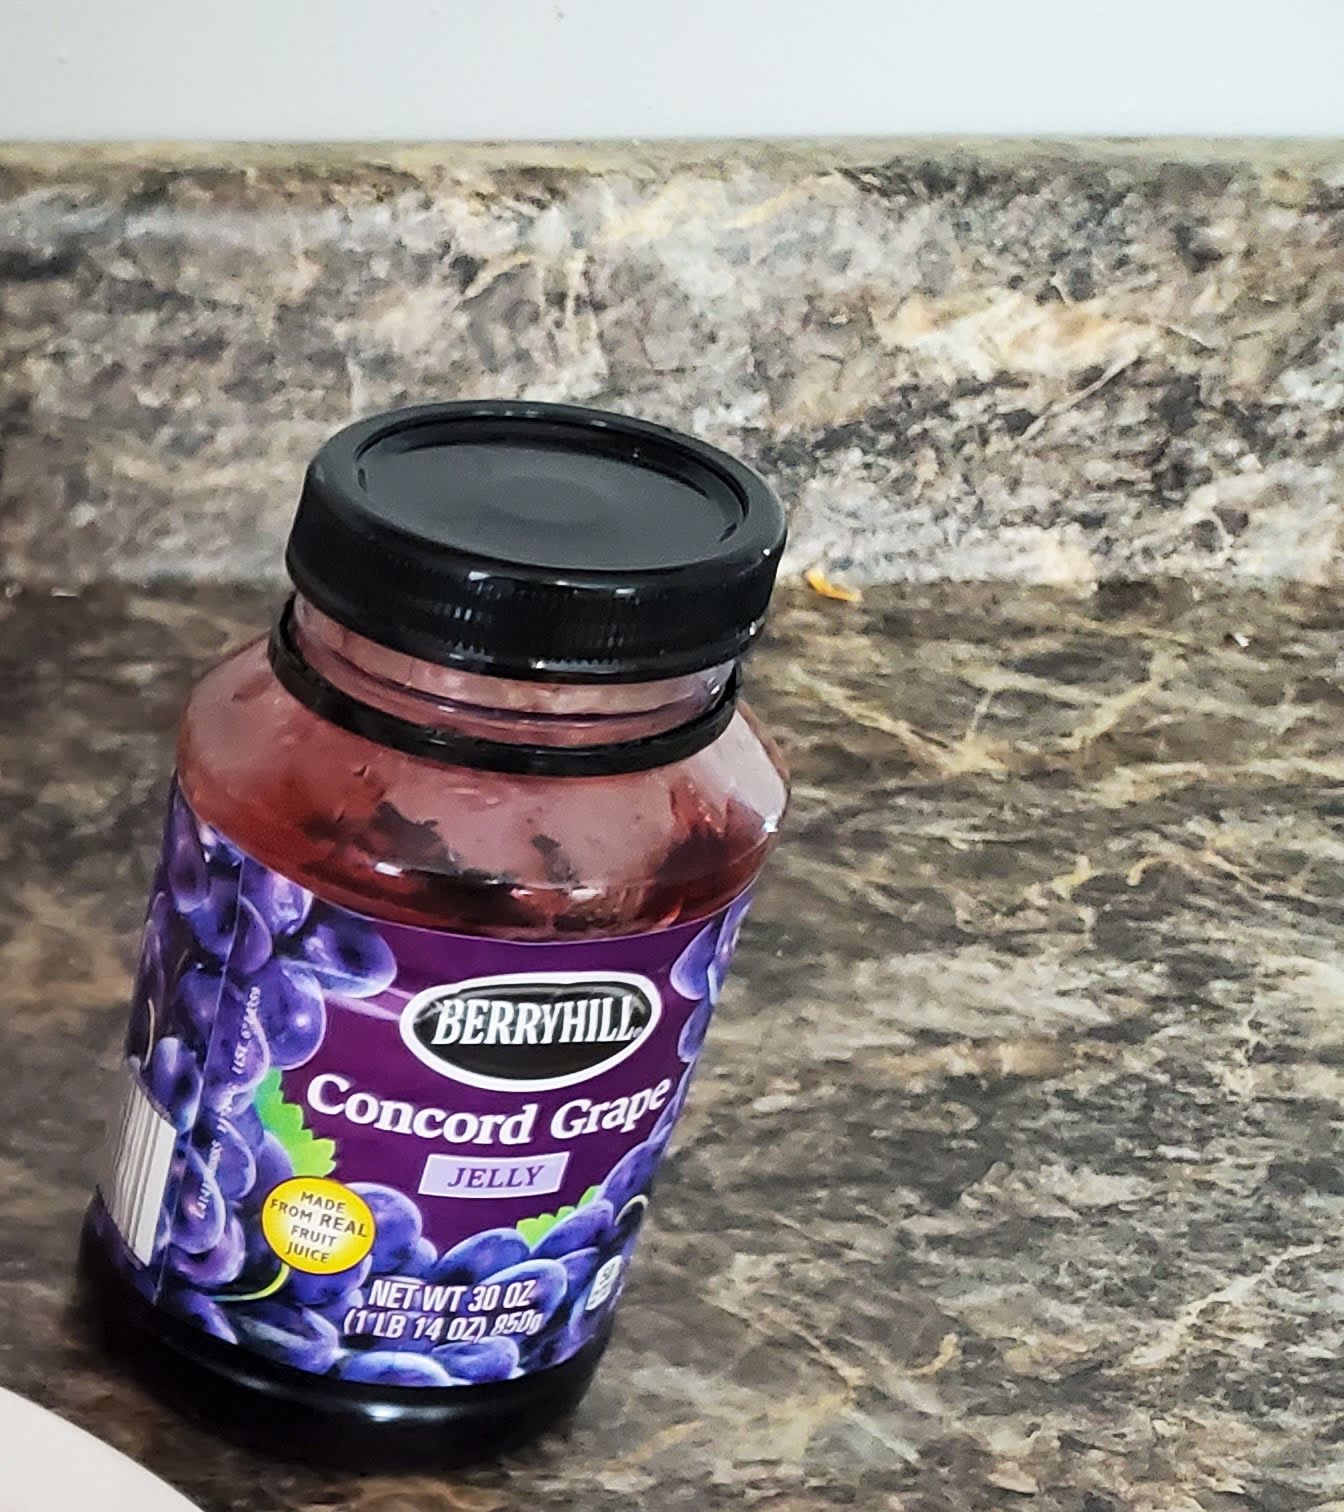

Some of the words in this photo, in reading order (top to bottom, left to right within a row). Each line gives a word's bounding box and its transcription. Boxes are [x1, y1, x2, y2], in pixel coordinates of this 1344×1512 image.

[430, 994, 638, 1045] BERRYHILL
[307, 1073, 538, 1145] Concord
[550, 1077, 672, 1139] Grape
[447, 1165, 545, 1190] JELLY
[270, 1198, 313, 1222] FROM
[319, 1213, 368, 1238] REAL
[300, 1191, 346, 1214] MADE
[286, 1241, 330, 1264] JUICE
[291, 1225, 337, 1247] FRUIT
[368, 1279, 420, 1309] NET
[422, 1285, 467, 1312] WT
[467, 1284, 500, 1311] 30
[502, 1280, 538, 1308] OZ
[373, 1312, 407, 1339] LB
[414, 1315, 442, 1341] 14
[446, 1315, 487, 1344] OZ)
[491, 1309, 544, 1336] 850g
